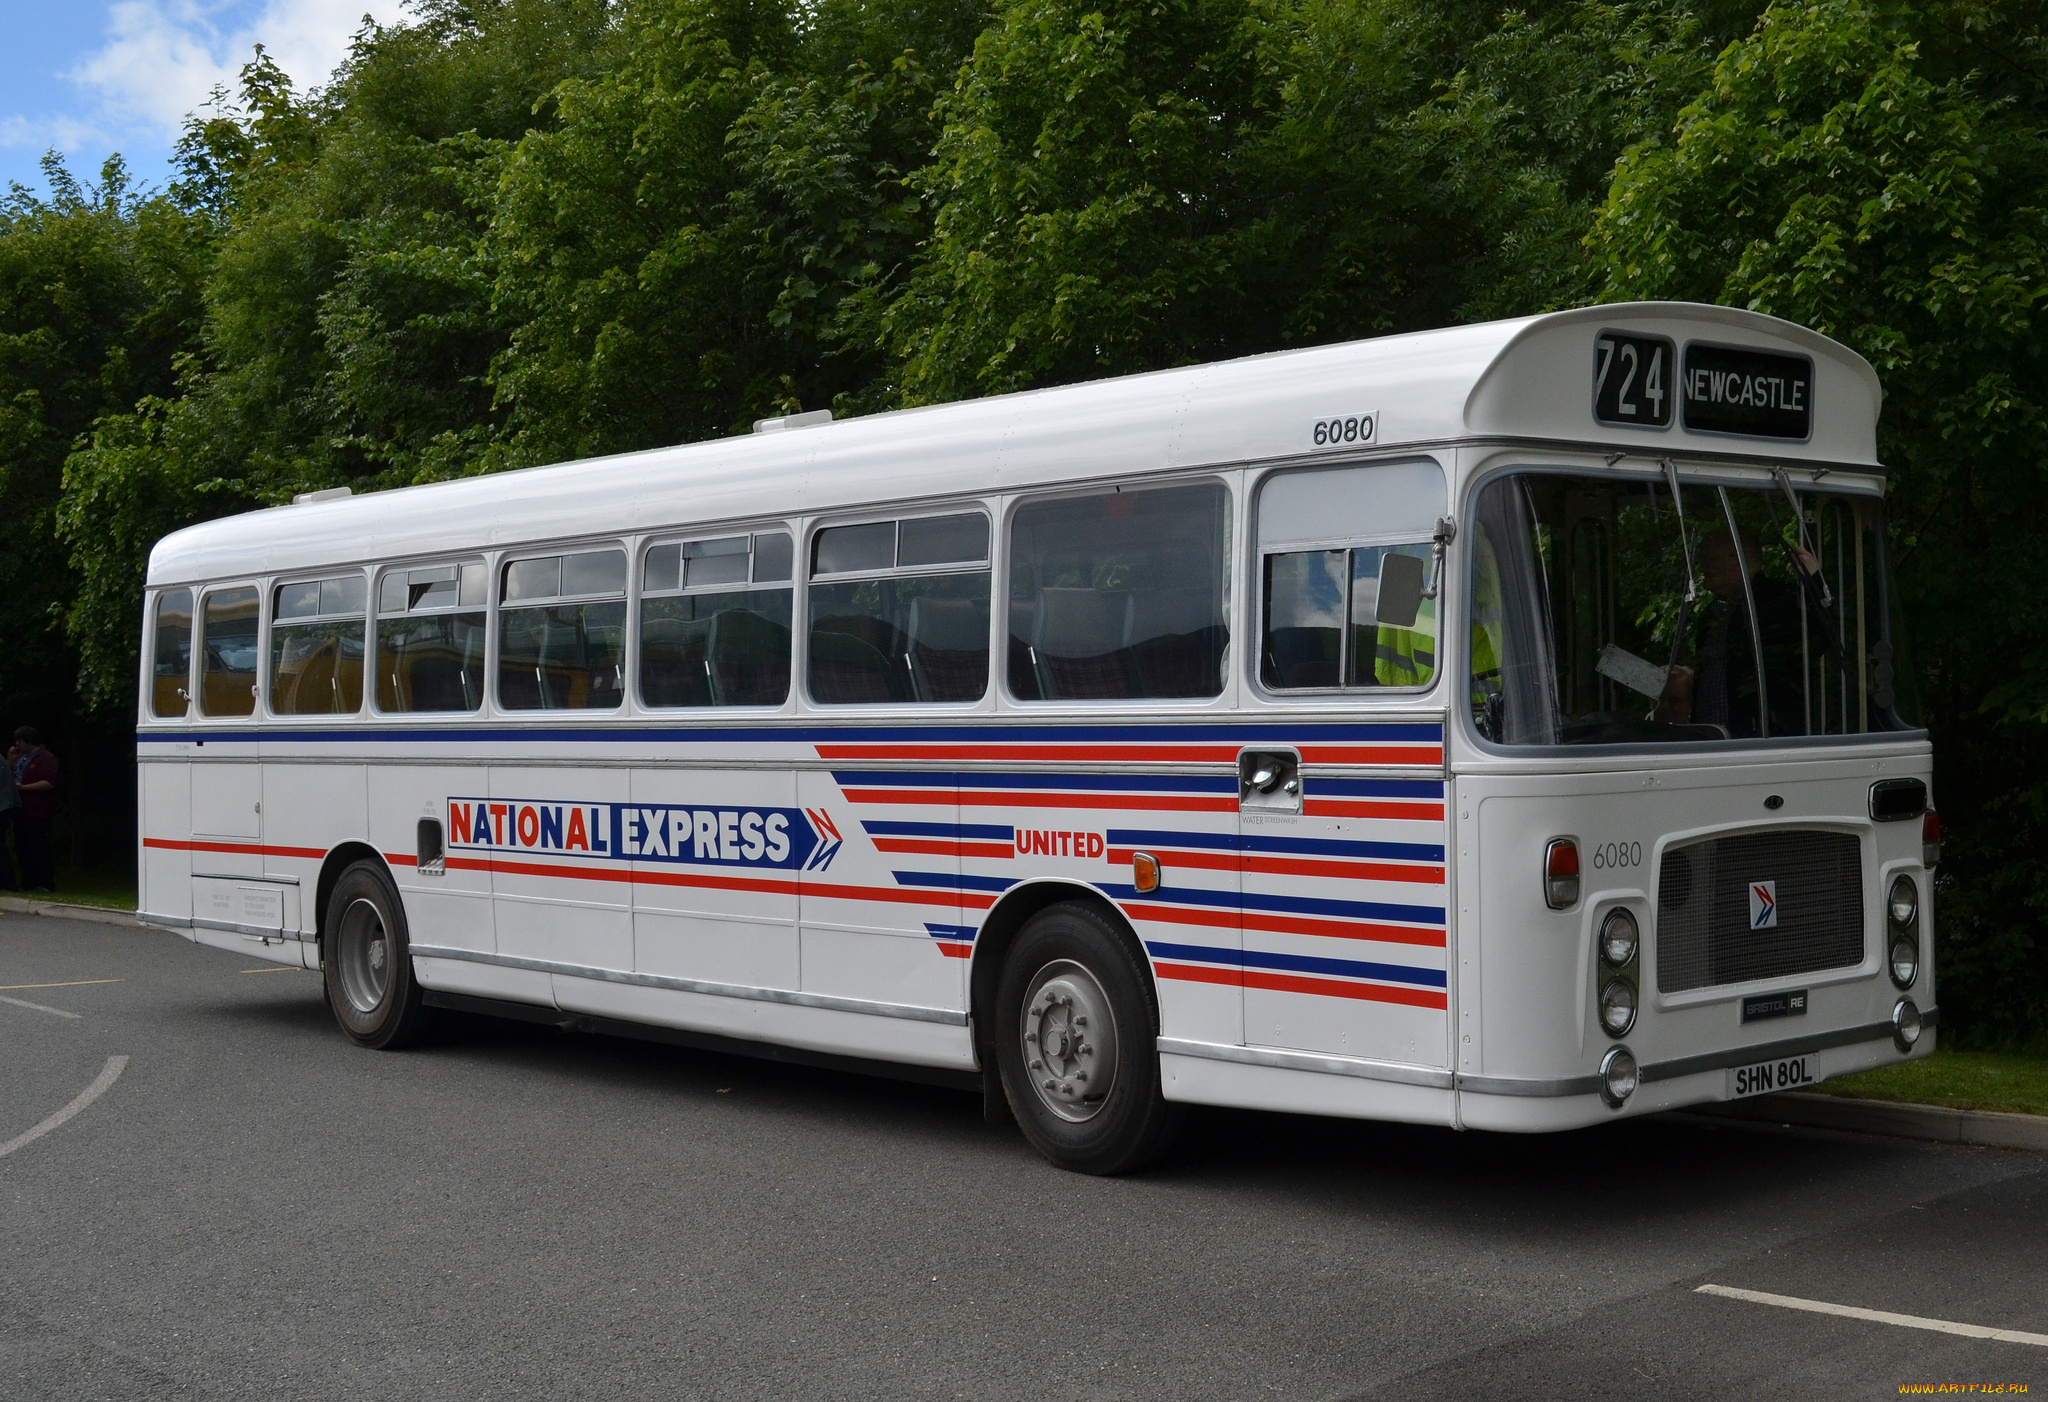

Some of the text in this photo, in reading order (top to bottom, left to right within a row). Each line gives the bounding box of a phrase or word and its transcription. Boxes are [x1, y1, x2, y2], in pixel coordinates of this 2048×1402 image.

[1596, 341, 1663, 418] 724
[1684, 368, 1805, 411] NEWCASTLE
[1313, 415, 1374, 445] 6080
[450, 802, 791, 862] NATIONAL EXPRESS
[1242, 815, 1264, 825] WATER
[1016, 829, 1105, 859] UNITED
[1593, 841, 1642, 869] 6080
[1746, 997, 1804, 1015] BRISTOL RE
[1736, 1056, 1812, 1094] SHN 80L
